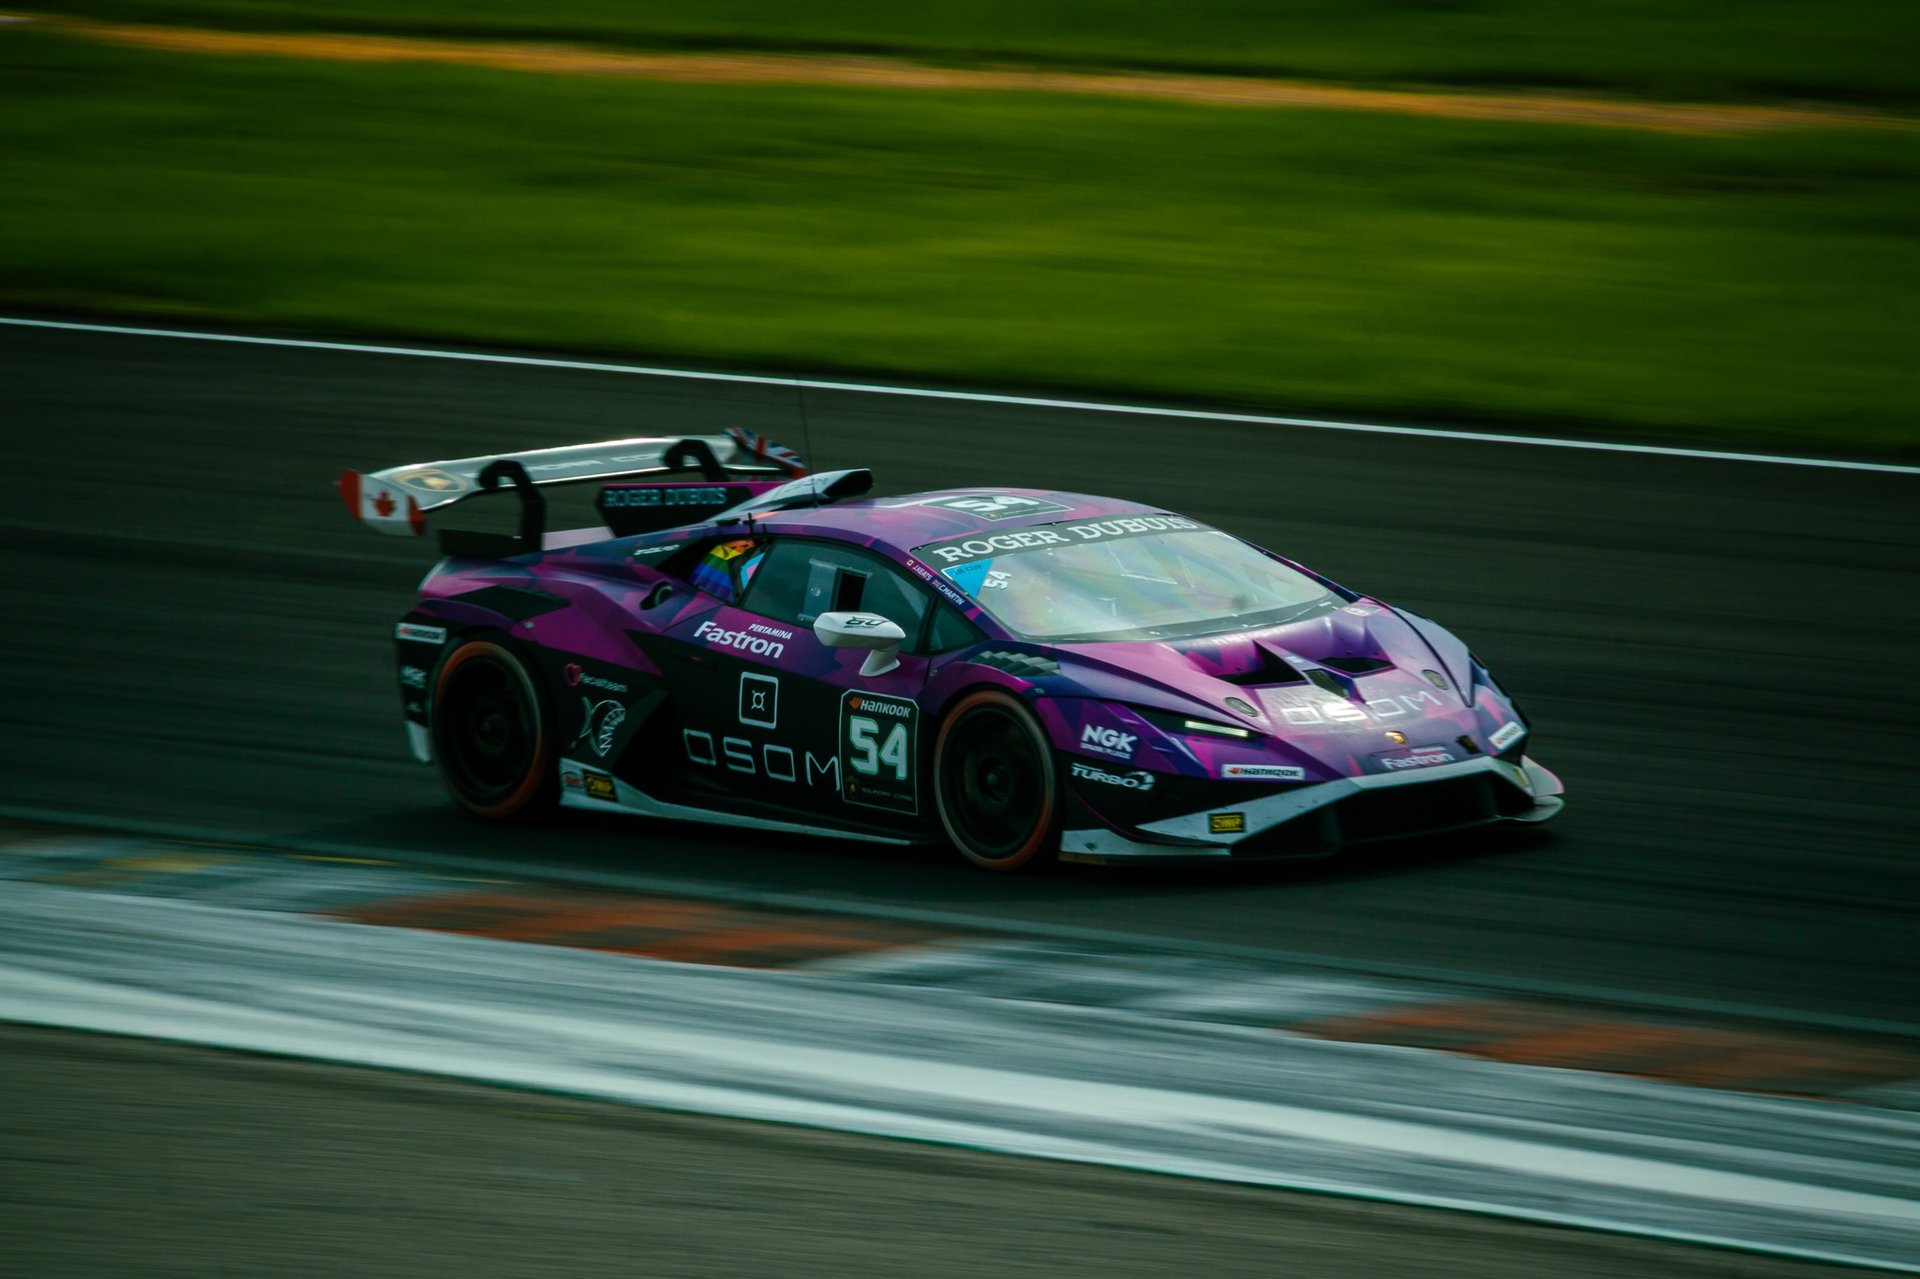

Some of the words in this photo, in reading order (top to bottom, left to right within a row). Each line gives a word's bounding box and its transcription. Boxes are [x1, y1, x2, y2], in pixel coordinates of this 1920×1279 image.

[944, 495, 1040, 511] 54
[932, 530, 1070, 562] ROGER
[1067, 516, 1198, 540] DUBUIS
[983, 570, 1012, 590] 54
[693, 621, 784, 659] Fastron
[748, 623, 793, 641] PERTAMINA
[1280, 690, 1442, 725] OSOM
[850, 715, 908, 781] 54
[1081, 723, 1138, 753] NGK
[682, 728, 841, 792] OSOM
[1382, 752, 1456, 770] Fastron
[1071, 766, 1139, 788] TURBO
